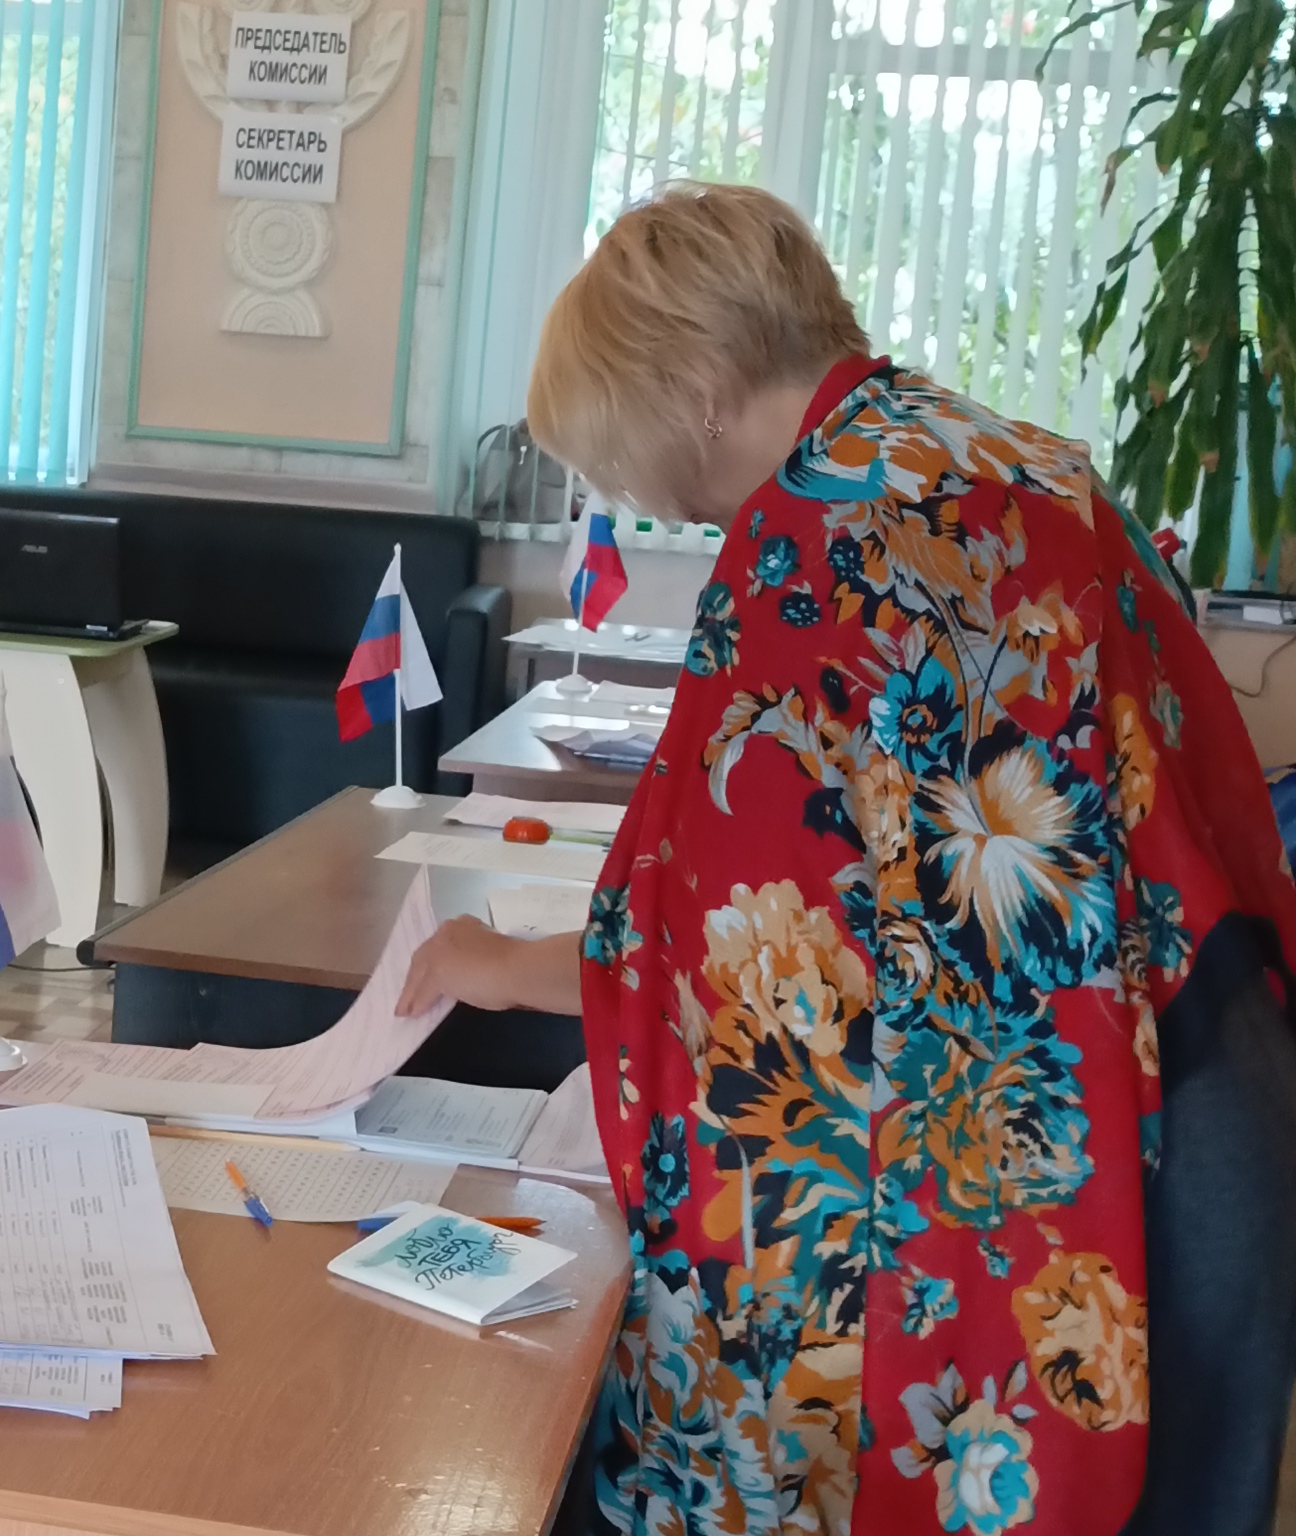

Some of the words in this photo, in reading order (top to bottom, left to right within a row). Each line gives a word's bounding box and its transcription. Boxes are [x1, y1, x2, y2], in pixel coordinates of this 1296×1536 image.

[235, 27, 347, 55] ПРЕДСЕДАТЕЛЬ
[248, 61, 328, 86] КОМИССИИ
[235, 127, 328, 153] СЕКРЕТАРЬ
[234, 159, 324, 185] КОМИССИИ
[418, 1238, 482, 1267] ТЕБЯ
